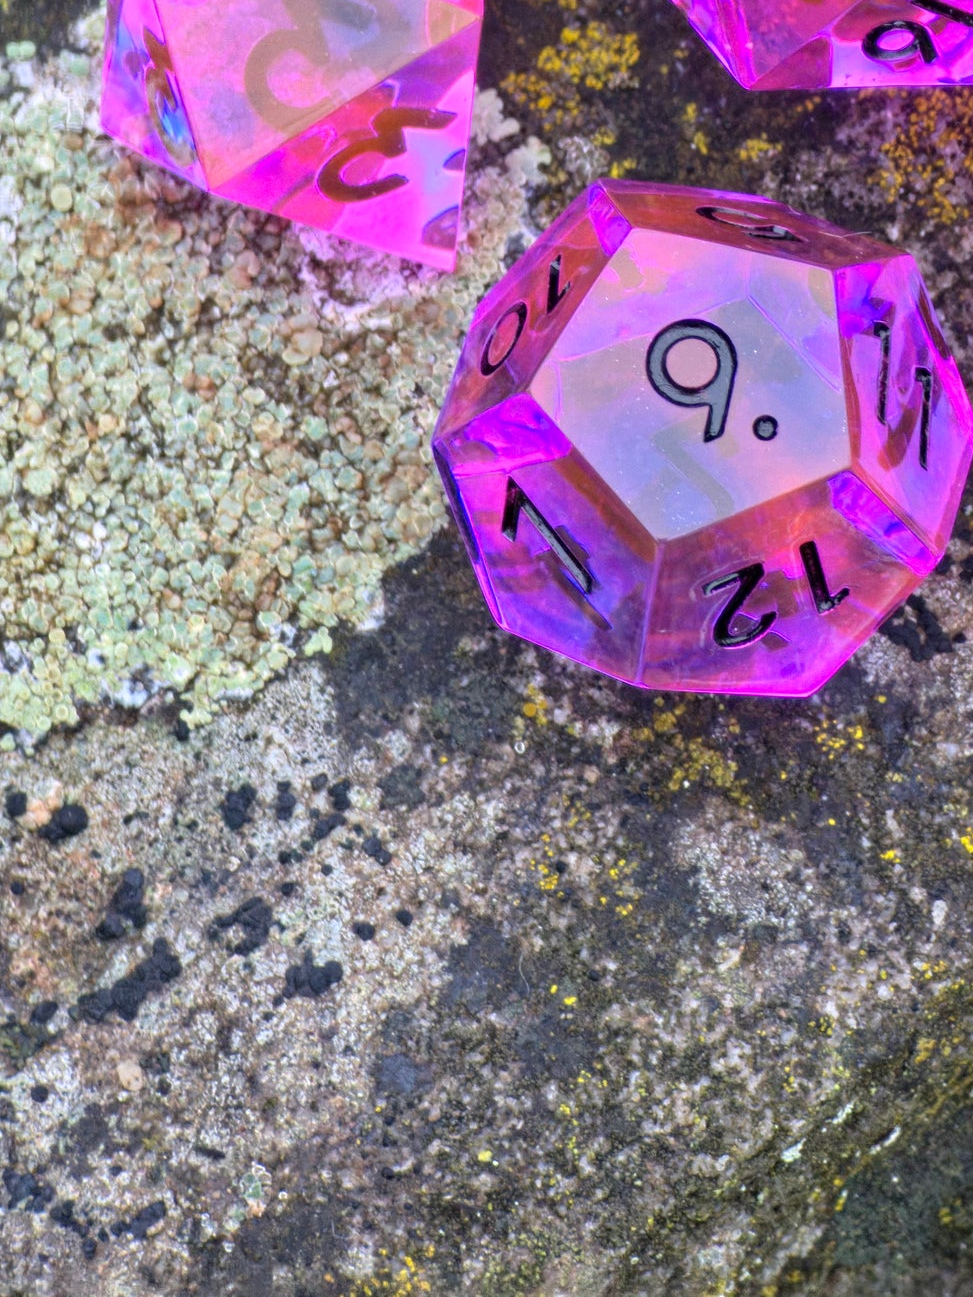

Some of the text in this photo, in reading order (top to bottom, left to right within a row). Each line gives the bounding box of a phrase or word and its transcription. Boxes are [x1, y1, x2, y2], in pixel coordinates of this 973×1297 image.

[479, 254, 572, 376] 10
[872, 319, 933, 471] 11
[701, 540, 850, 650] 12
